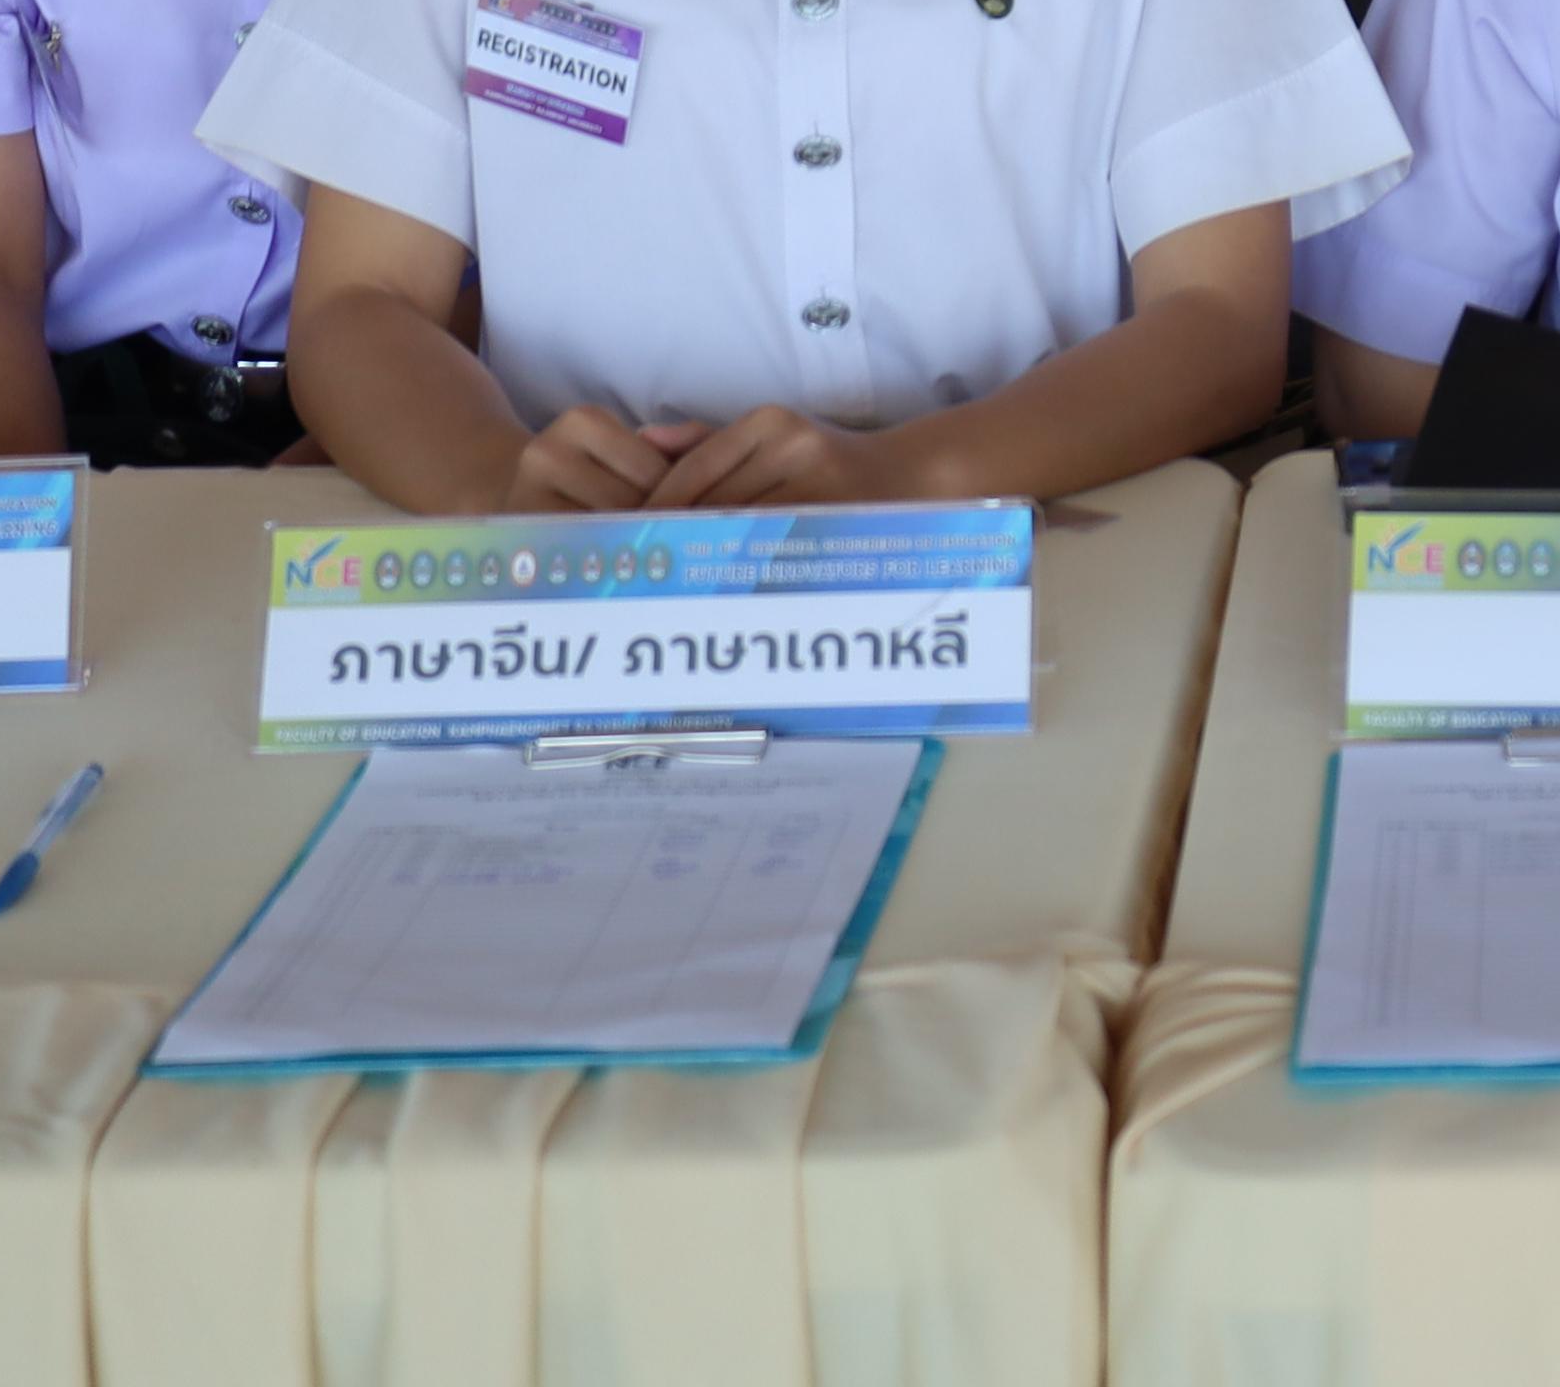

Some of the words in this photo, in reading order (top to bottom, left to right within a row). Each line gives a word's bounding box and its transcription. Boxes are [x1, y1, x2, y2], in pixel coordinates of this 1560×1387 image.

[477, 28, 628, 95] REGISTRATION
[330, 622, 598, 682] ภาษาจีน/
[624, 611, 969, 676] ภาษาเกาหลี
